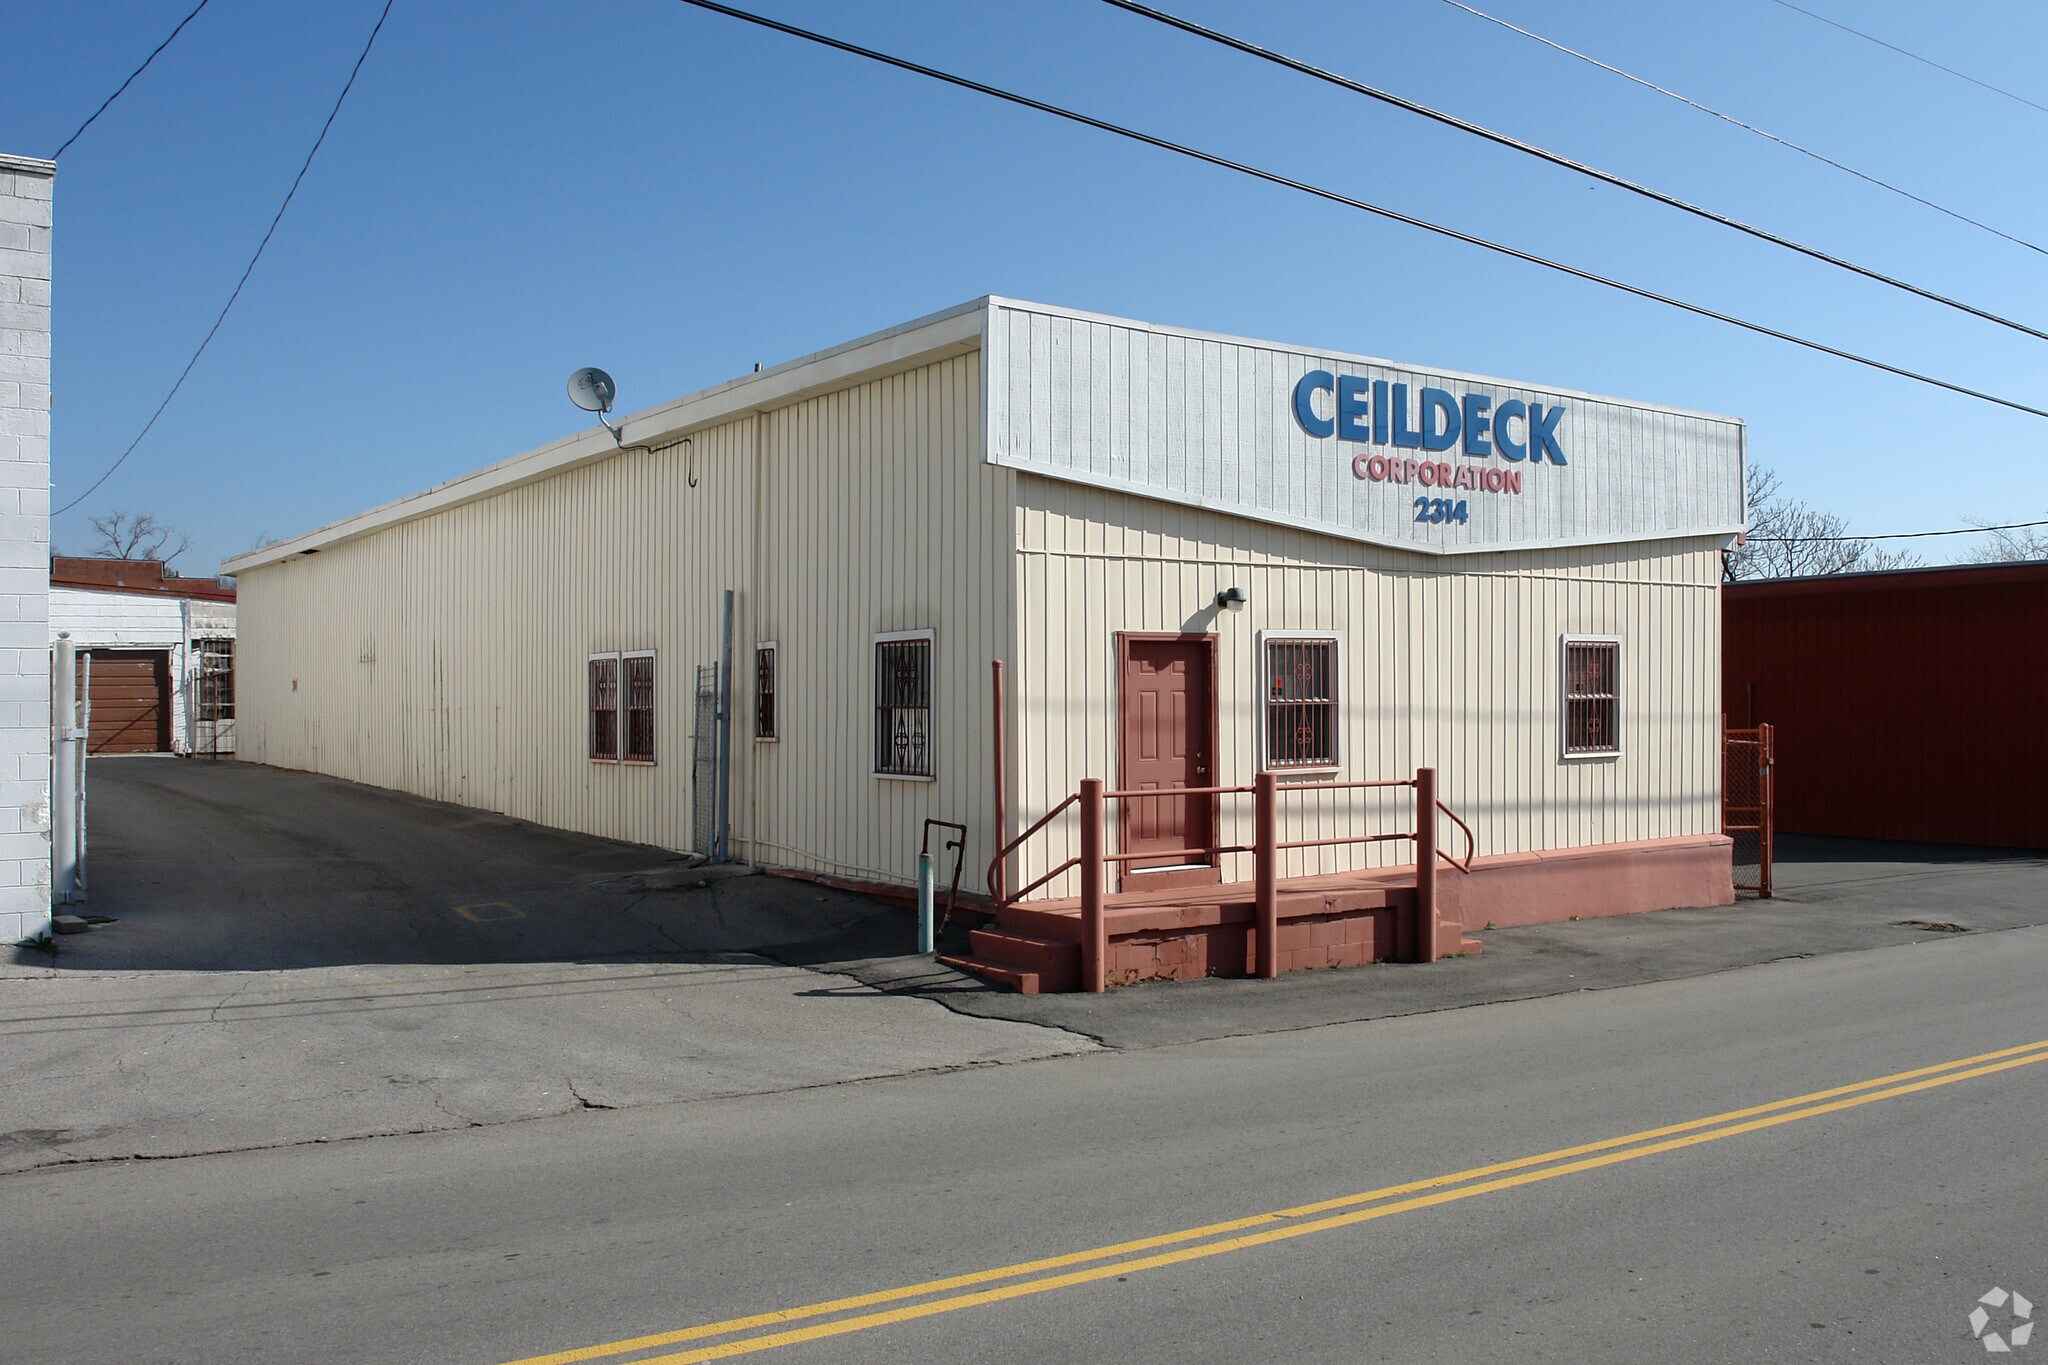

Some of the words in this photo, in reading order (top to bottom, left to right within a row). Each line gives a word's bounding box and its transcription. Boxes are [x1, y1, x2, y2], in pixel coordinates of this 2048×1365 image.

[1292, 370, 1567, 465] CEILDECK
[1352, 454, 1521, 493] CORPORATION
[1413, 496, 1468, 525] 2314
